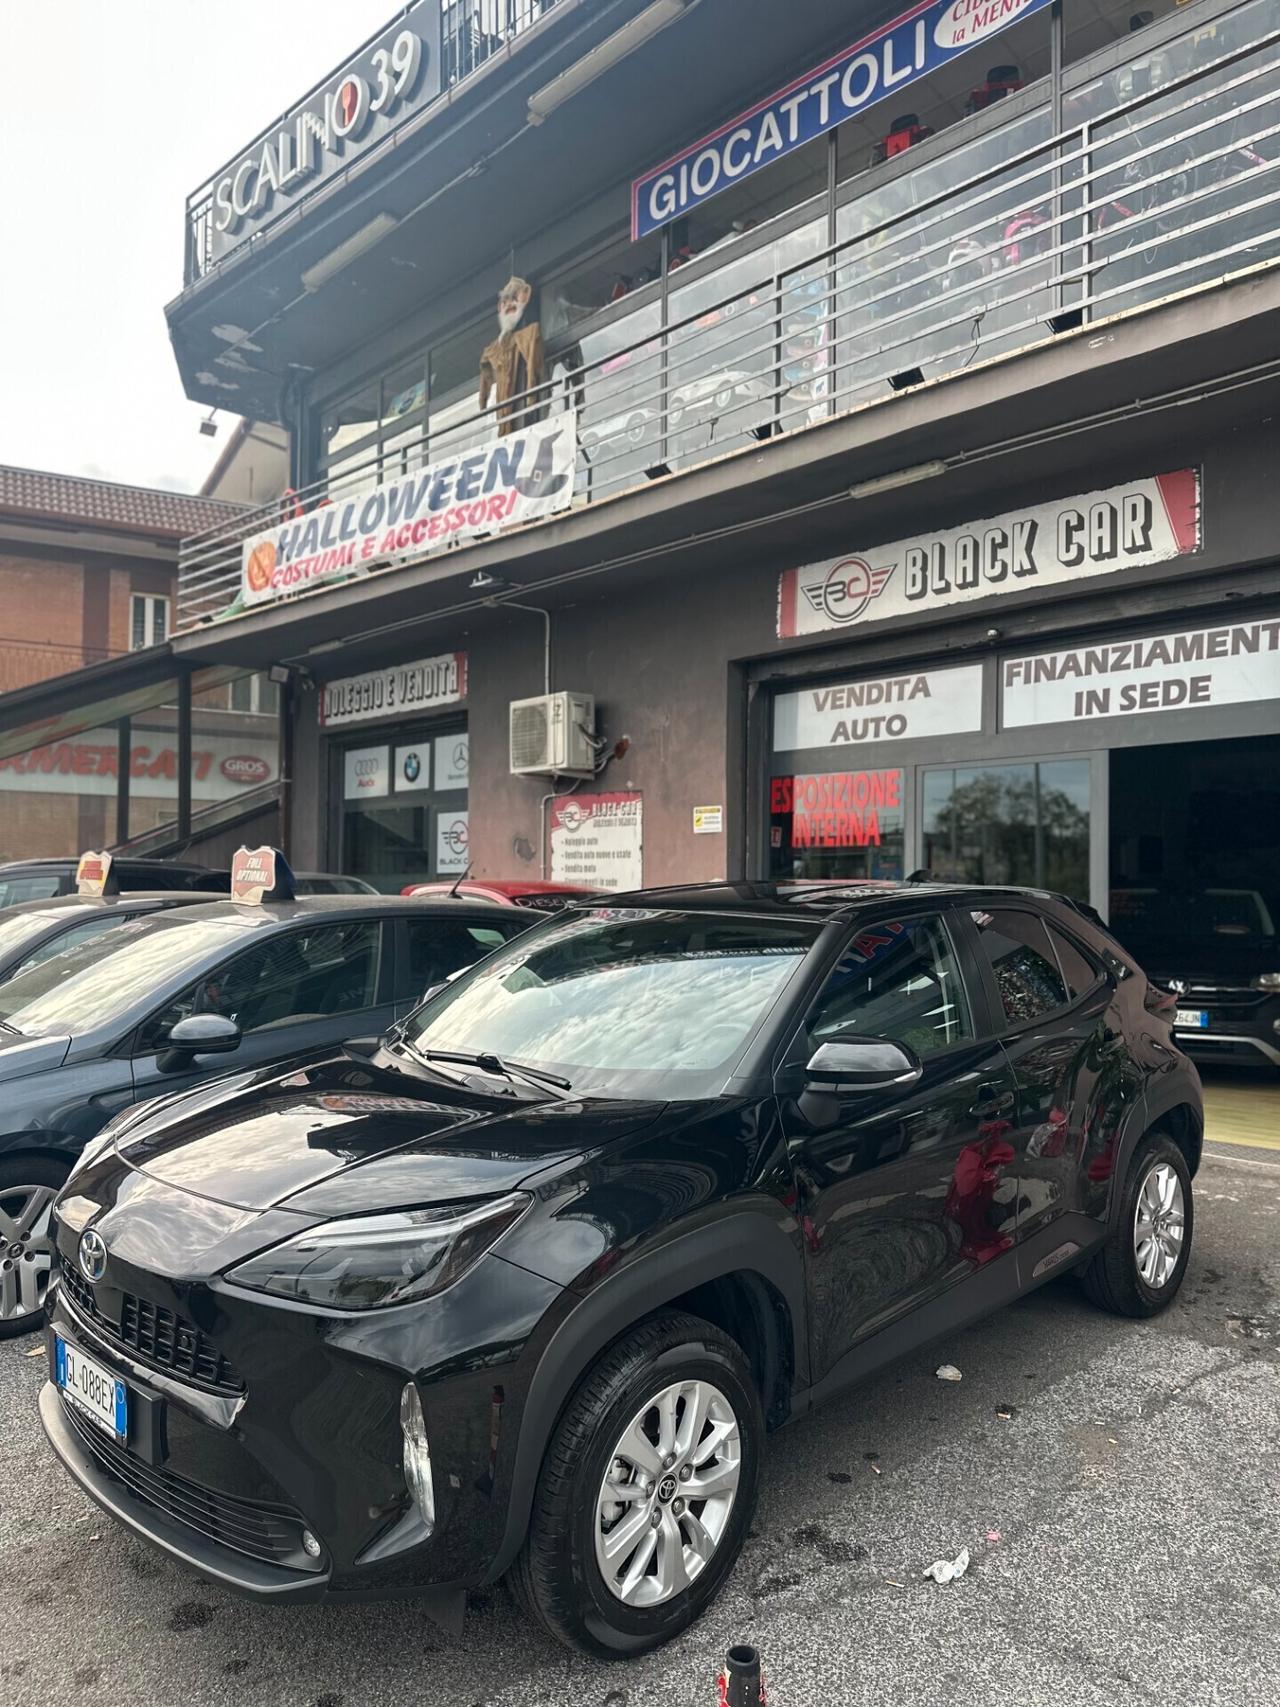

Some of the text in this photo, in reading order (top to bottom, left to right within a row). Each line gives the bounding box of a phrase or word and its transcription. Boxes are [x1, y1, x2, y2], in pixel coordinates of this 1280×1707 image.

[952, 29, 965, 44] la
[370, 30, 419, 113] 39
[650, 19, 926, 221] GIOCATTOLI
[275, 440, 526, 567] HALLOWEEN
[271, 490, 518, 589] COSTUMI E ACCESSORI
[905, 493, 1152, 600] BLACK CAR
[324, 661, 459, 719] NOLEGGIO E VENDITA
[813, 676, 931, 712] VENDITA
[1074, 675, 1212, 717] IN SEDE
[830, 714, 907, 743] AUTO
[225, 760, 265, 773] GROS
[771, 769, 901, 813] ESPOSIZIONE
[792, 809, 881, 848] INTERNA
[82, 1364, 115, 1418] 088EX
